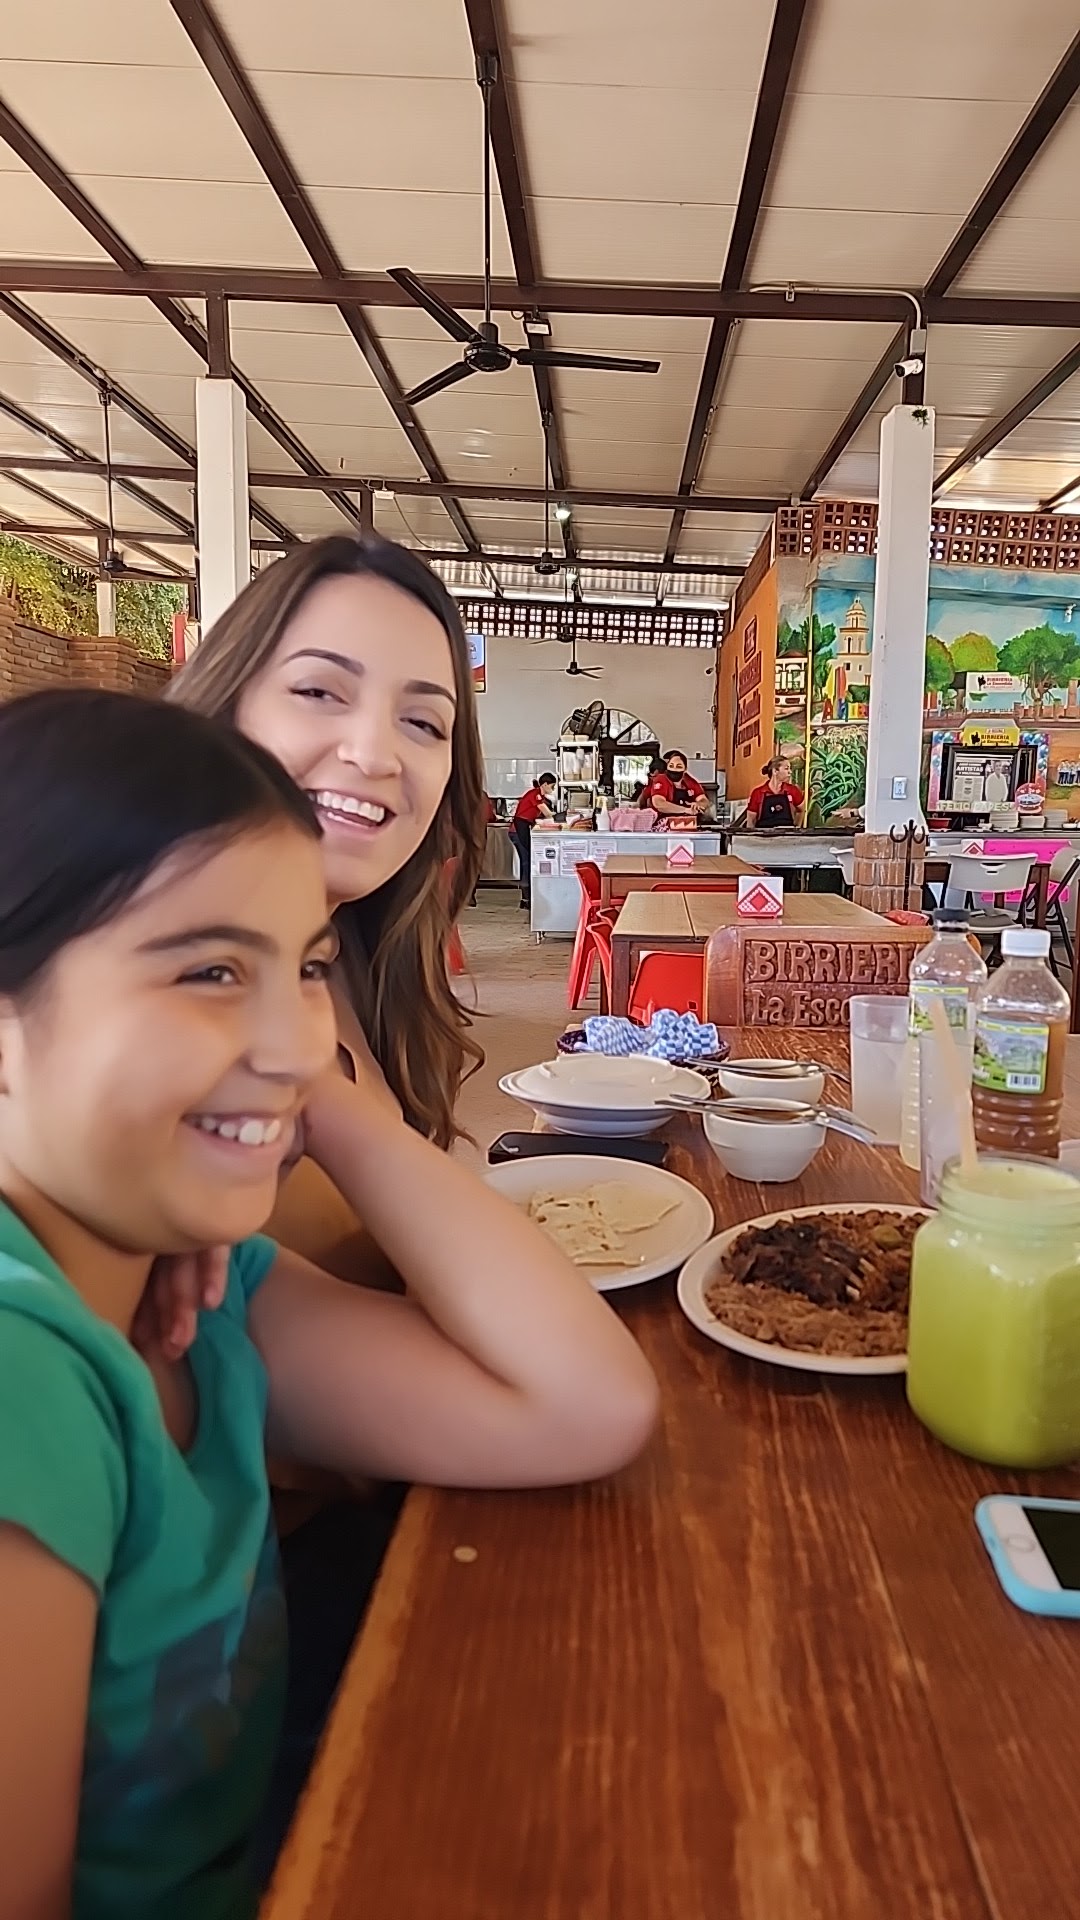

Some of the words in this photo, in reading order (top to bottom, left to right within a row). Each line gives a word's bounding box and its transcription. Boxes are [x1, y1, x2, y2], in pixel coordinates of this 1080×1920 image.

[751, 941, 917, 984] BIRRIERI
[752, 990, 786, 1026] La
[792, 990, 851, 1027] Esco
